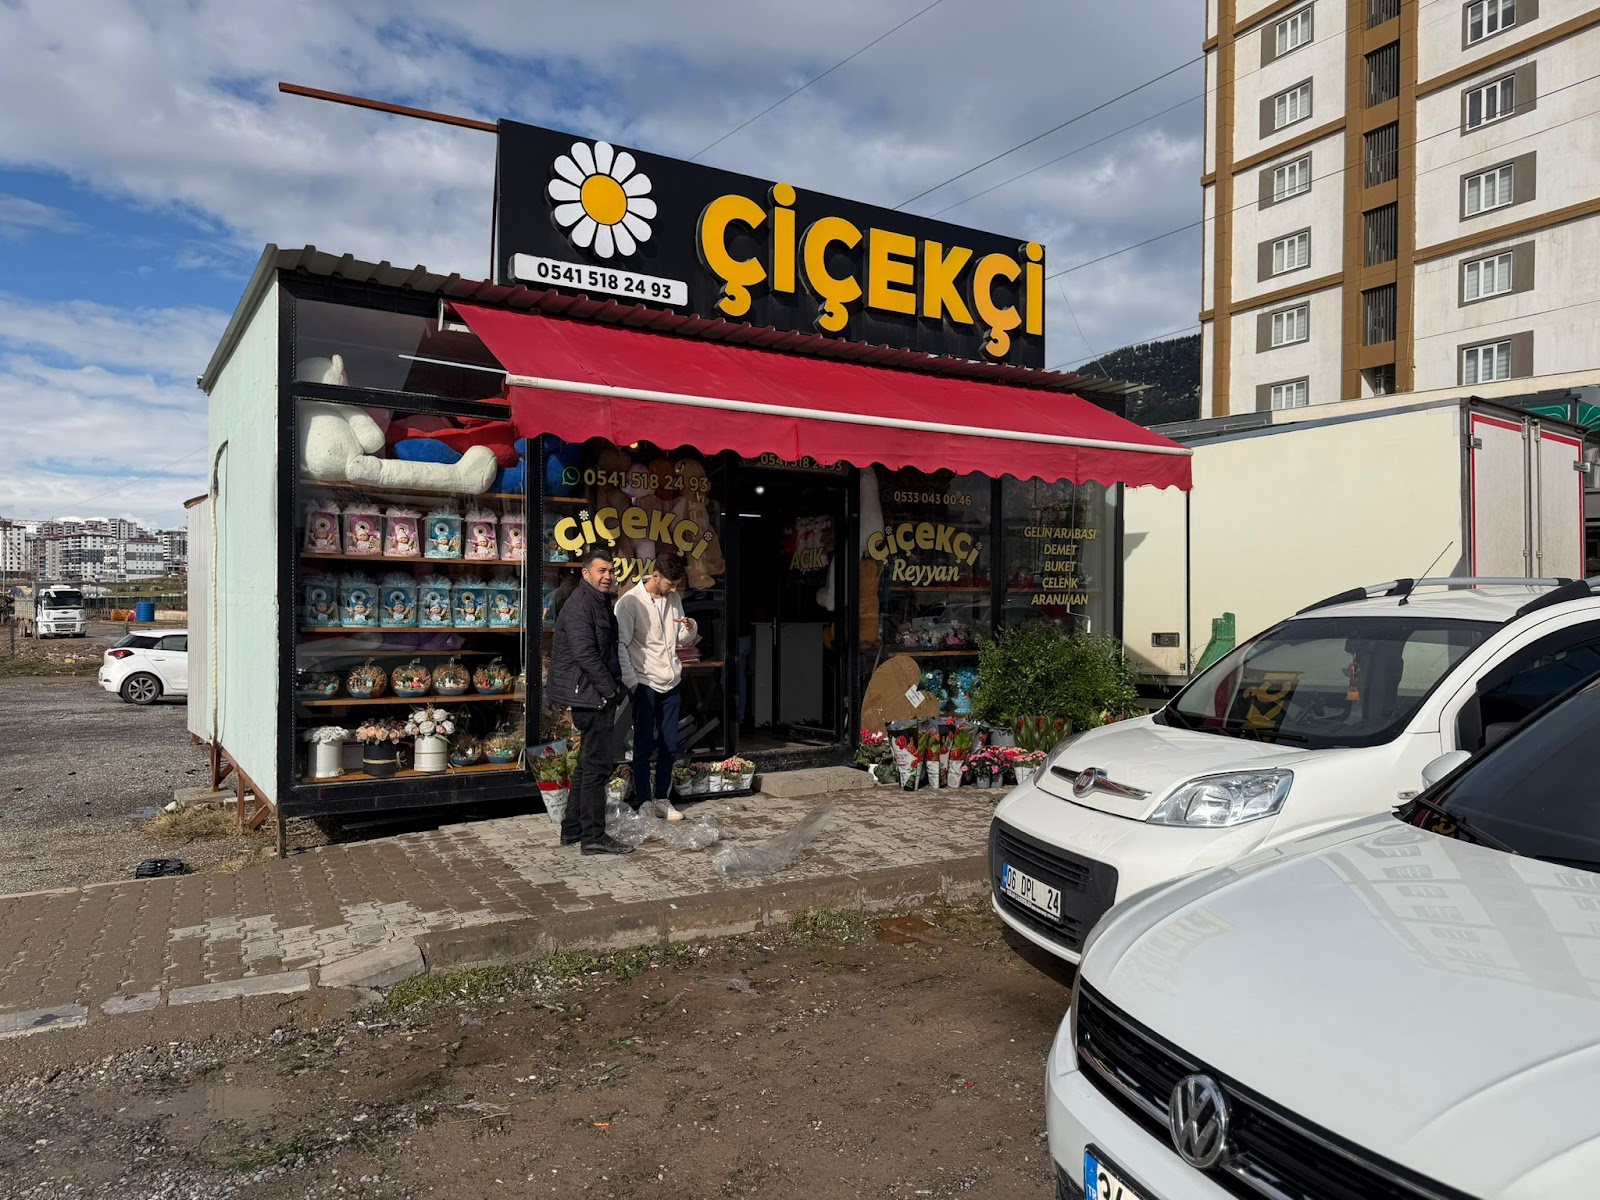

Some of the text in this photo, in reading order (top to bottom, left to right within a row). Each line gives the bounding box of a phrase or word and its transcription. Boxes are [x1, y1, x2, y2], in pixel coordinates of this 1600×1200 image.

[700, 183, 1043, 358] ÇİÇEKÇİ
[537, 262, 672, 299] 0541 518 24 93
[584, 468, 709, 492] 0541 518 24 93
[894, 490, 972, 506] 0533 043 00 46
[1023, 524, 1097, 540] GELİN ARABASI
[1043, 543, 1078, 556] DEMET
[892, 558, 960, 587] Reyyan
[1044, 560, 1077, 573] BUKET
[1042, 577, 1079, 591] ÇELENK
[1031, 593, 1089, 606] ARANJMAN
[1007, 867, 1017, 890] 06
[1047, 888, 1059, 914] 24
